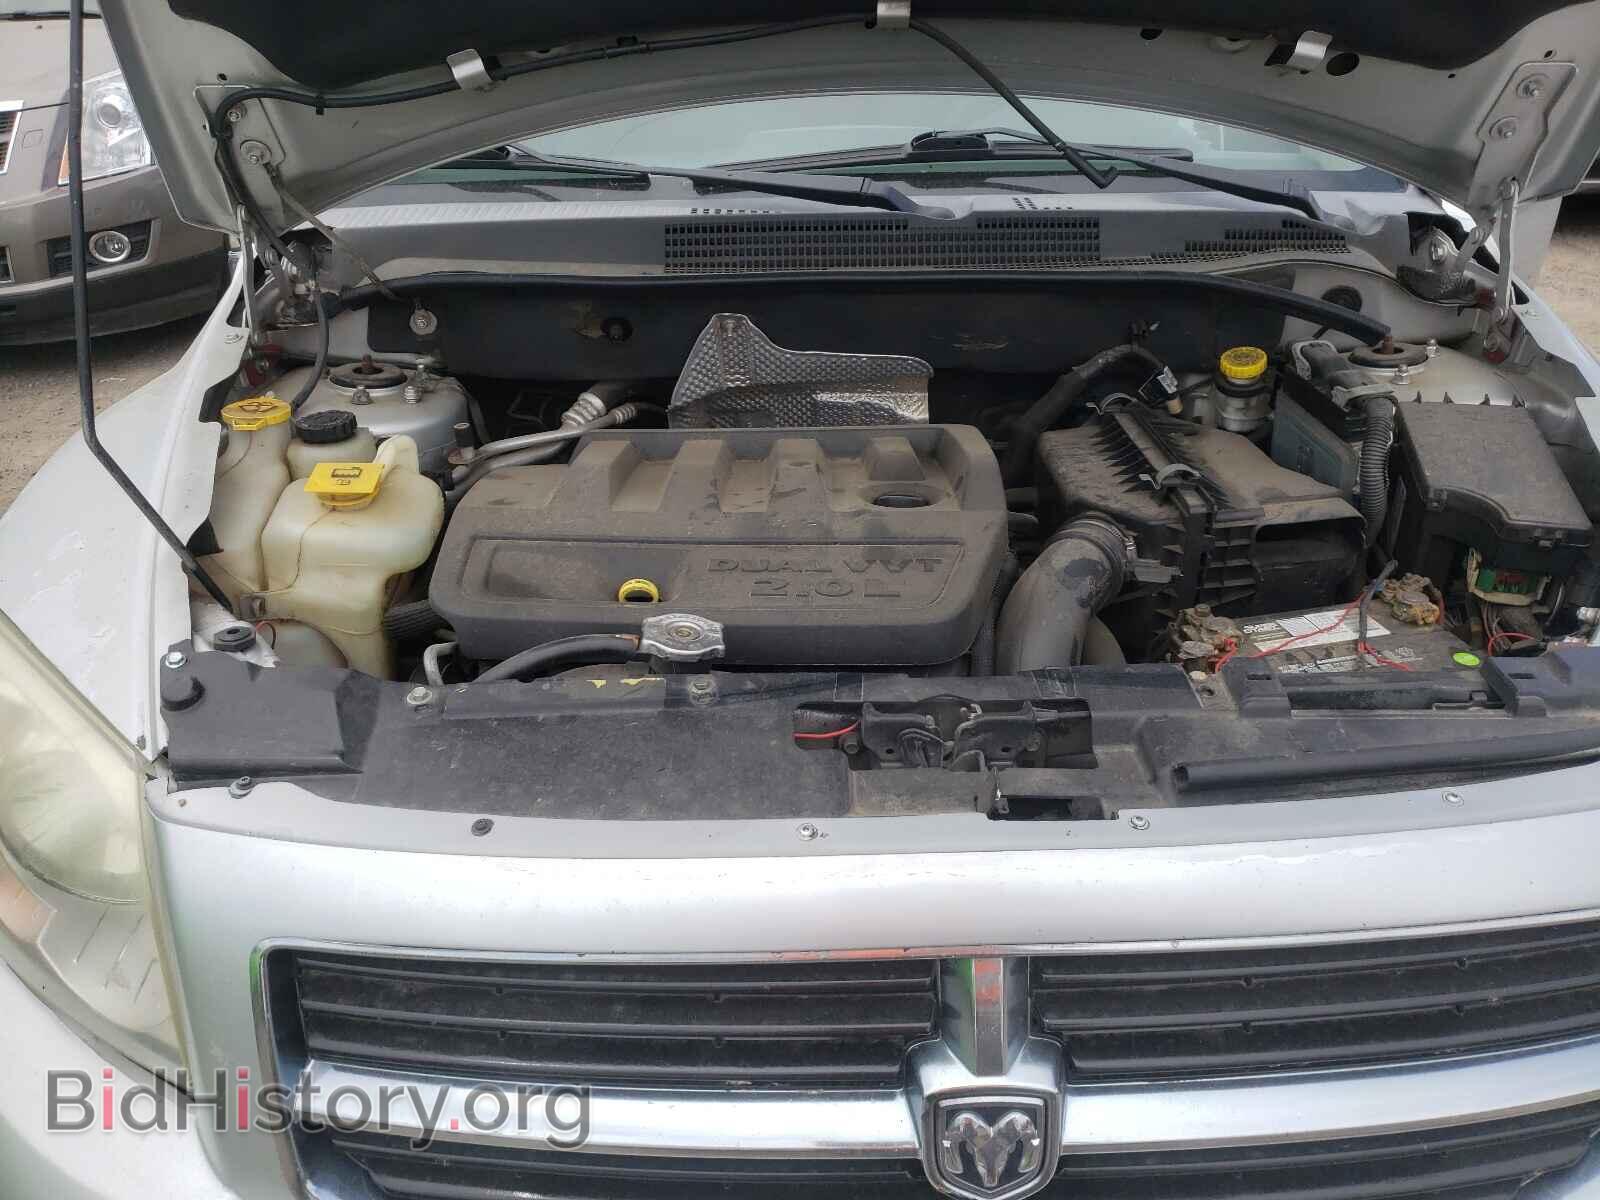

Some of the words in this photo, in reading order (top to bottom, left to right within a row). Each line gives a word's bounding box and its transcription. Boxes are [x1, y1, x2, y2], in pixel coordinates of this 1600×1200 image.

[707, 557, 833, 574] DUAL
[842, 556, 943, 574] VVT
[749, 577, 902, 598] 2.0L
